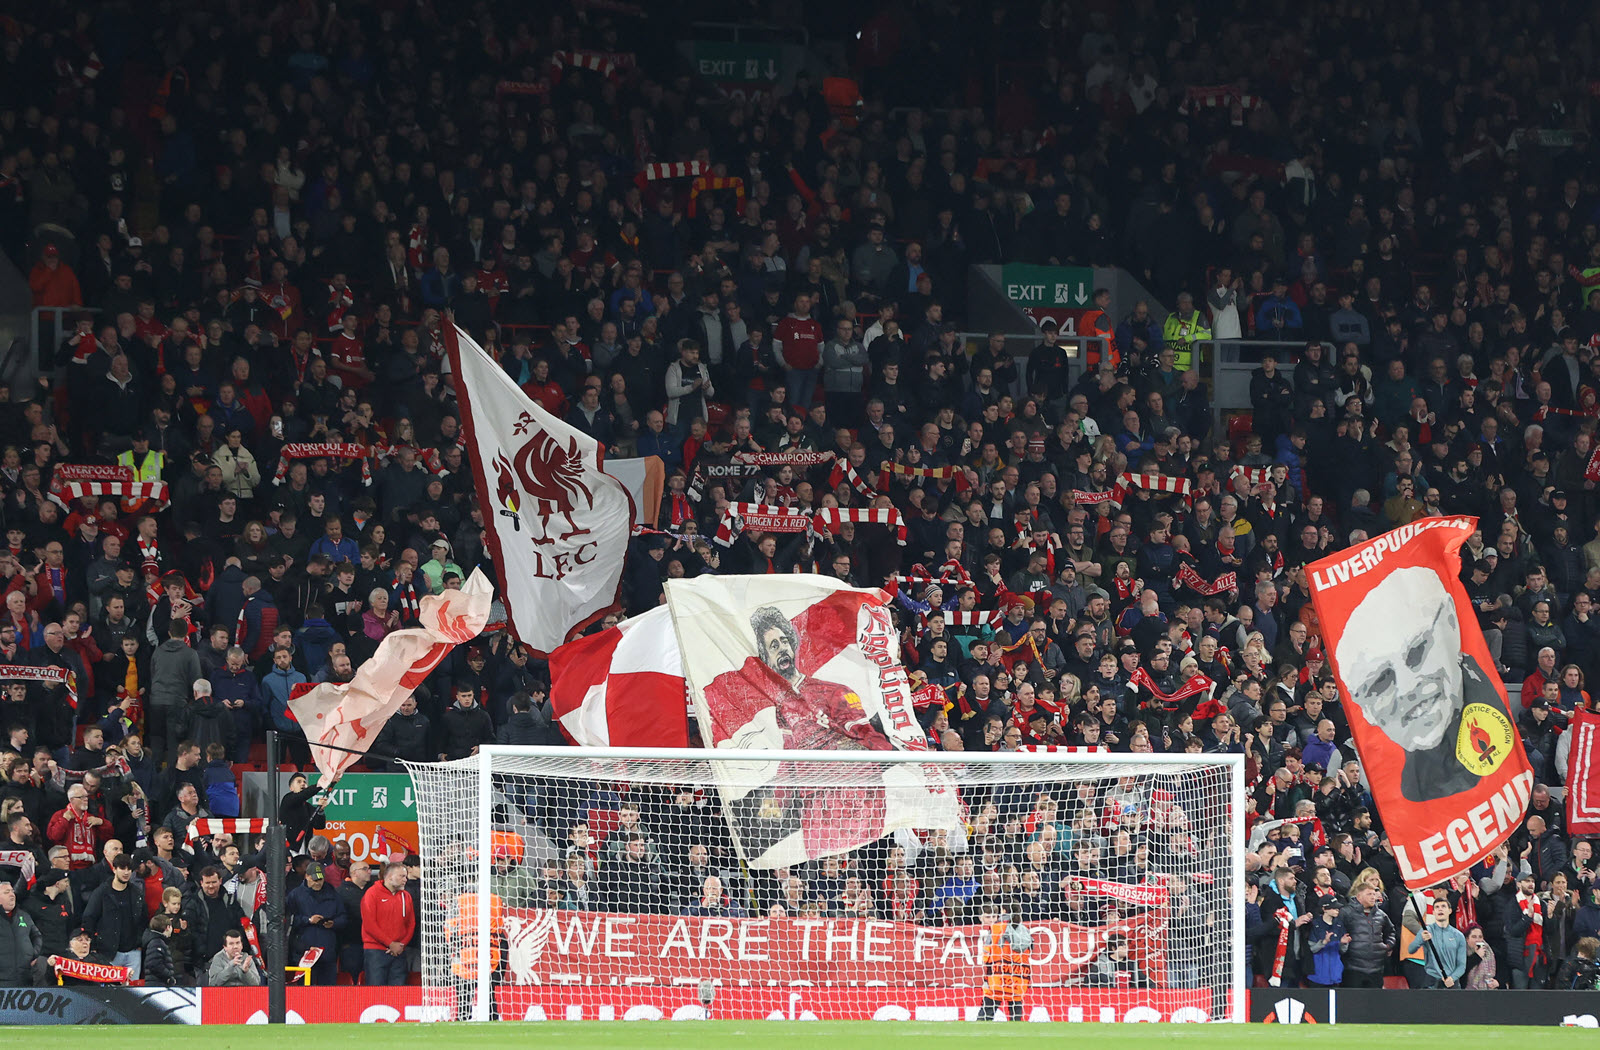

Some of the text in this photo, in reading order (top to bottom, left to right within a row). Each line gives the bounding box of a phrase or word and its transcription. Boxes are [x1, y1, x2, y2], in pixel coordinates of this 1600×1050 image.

[699, 59, 737, 76] EXIT
[1007, 284, 1046, 301] EXIT
[287, 443, 359, 453] LIVERPOOL FC
[758, 453, 817, 462] CHAMPIONS
[61, 465, 128, 477] LIVERPOOL FC
[707, 465, 758, 477] ROME 77
[745, 516, 807, 528] JURGEN IS A RED
[1312, 517, 1471, 592] LIVERPUDLIAN
[1491, 711, 1512, 745] CAMPAIGN
[312, 788, 358, 806] EXIT
[1392, 768, 1535, 882] LEGEND
[8, 851, 26, 863] FC
[550, 916, 637, 958] WE
[659, 919, 771, 961] ARE
[792, 920, 894, 962] THE
[60, 959, 124, 980] LIVERPOOL
[0, 989, 73, 1018] KOOK
